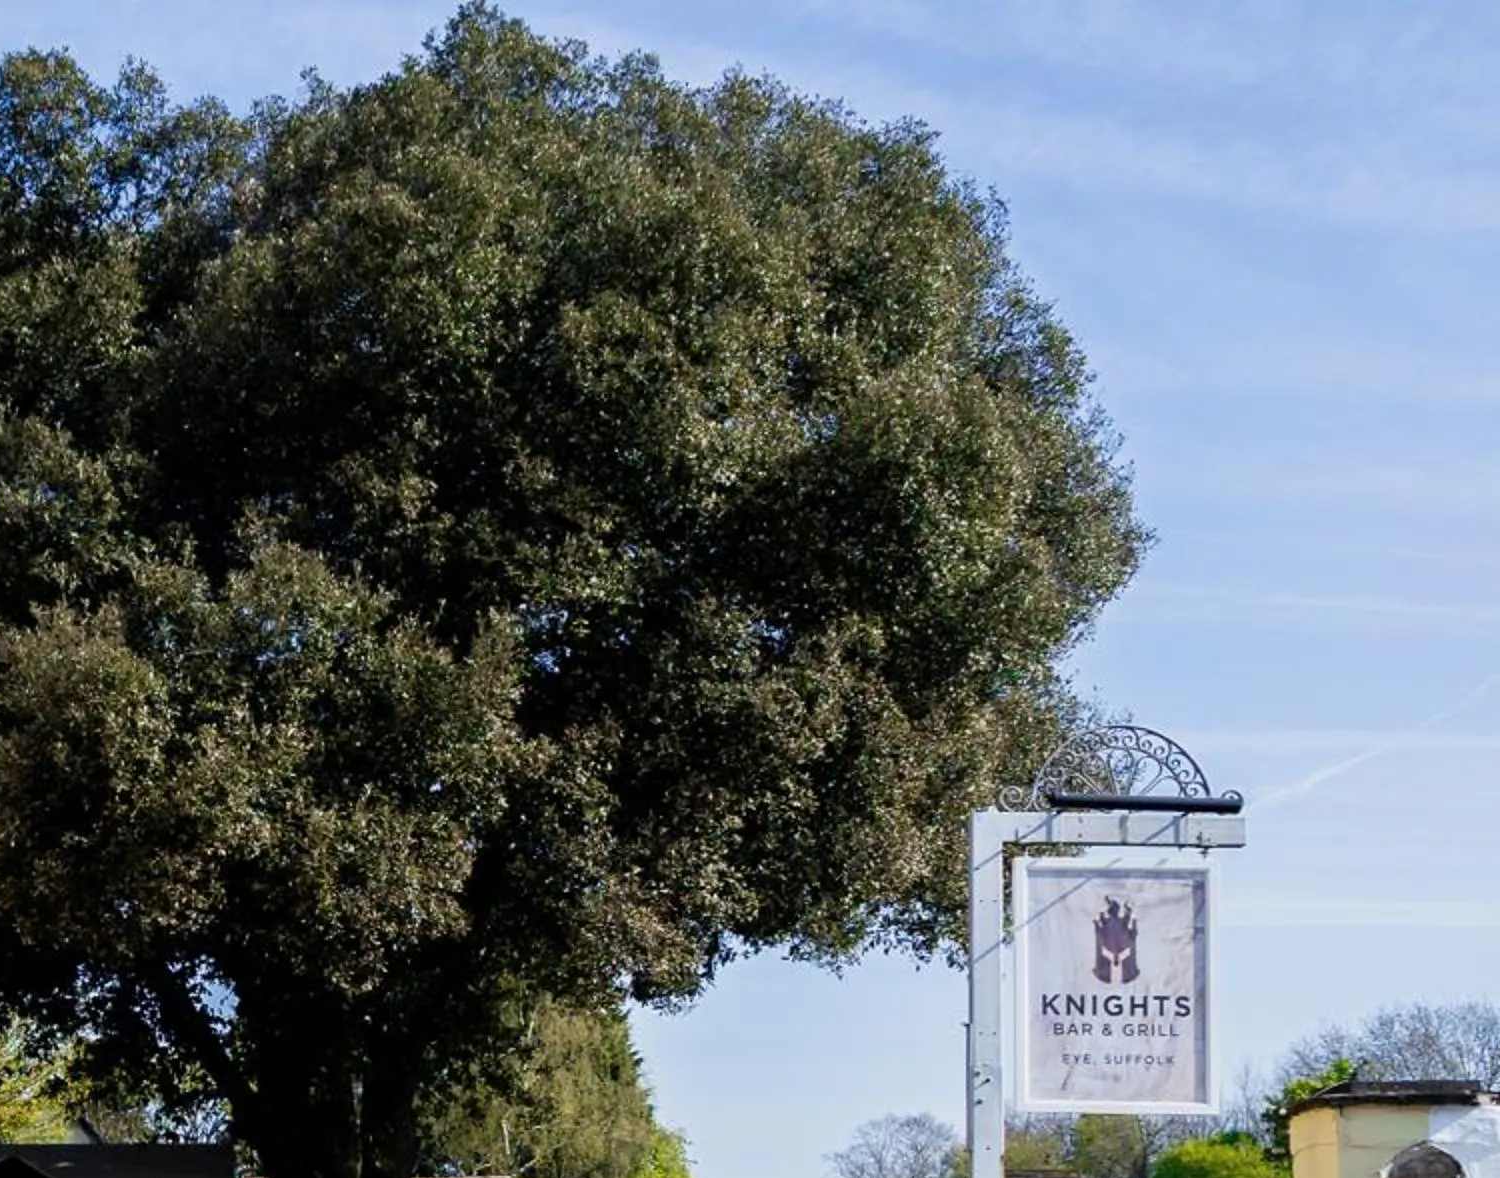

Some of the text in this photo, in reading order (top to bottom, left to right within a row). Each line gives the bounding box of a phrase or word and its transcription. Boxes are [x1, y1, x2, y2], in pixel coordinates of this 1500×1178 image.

[1041, 993, 1191, 1017] KNIGHTS
[1053, 1023, 1180, 1037] BAR & GRILL
[1104, 1054, 1175, 1066] SUFFOLK
